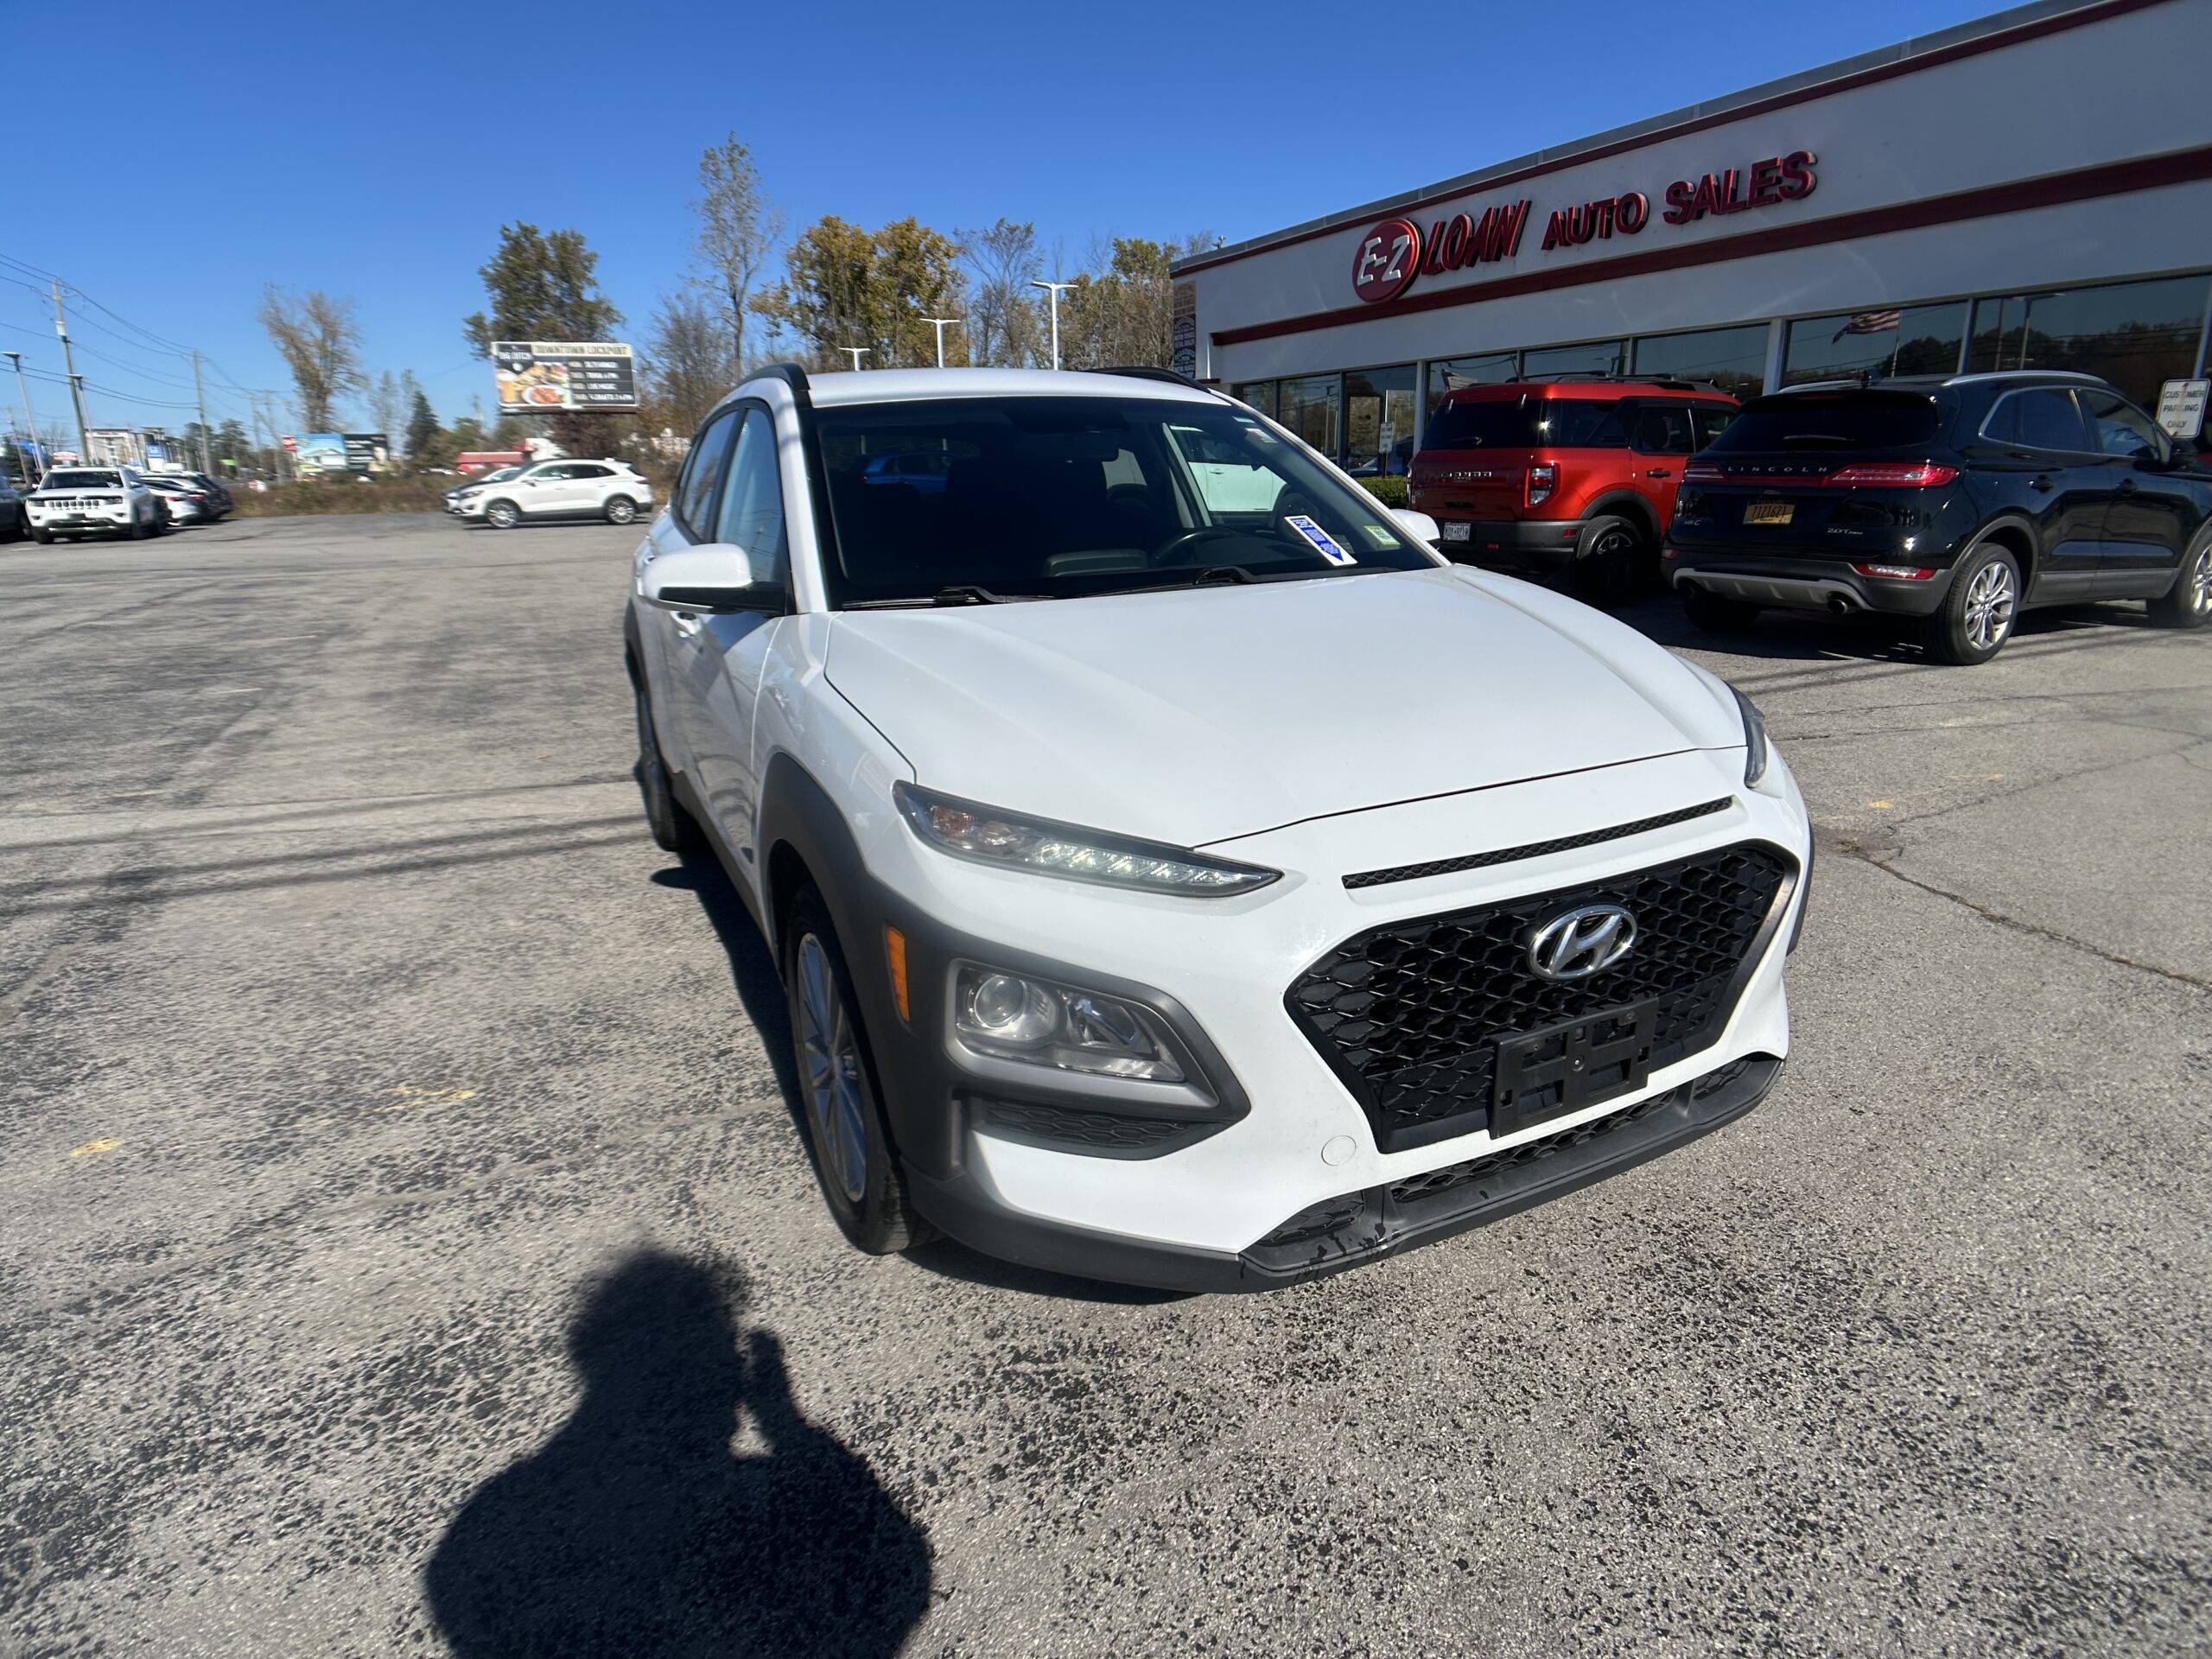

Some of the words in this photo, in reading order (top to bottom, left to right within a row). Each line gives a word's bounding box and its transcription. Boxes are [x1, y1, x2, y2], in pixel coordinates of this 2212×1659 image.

[1357, 234, 1410, 287] E-Z
[1421, 200, 1531, 275] LOAN
[1541, 193, 1649, 251] AUTO
[1662, 150, 1817, 226] SALES
[2165, 390, 2205, 398] CUSMER
